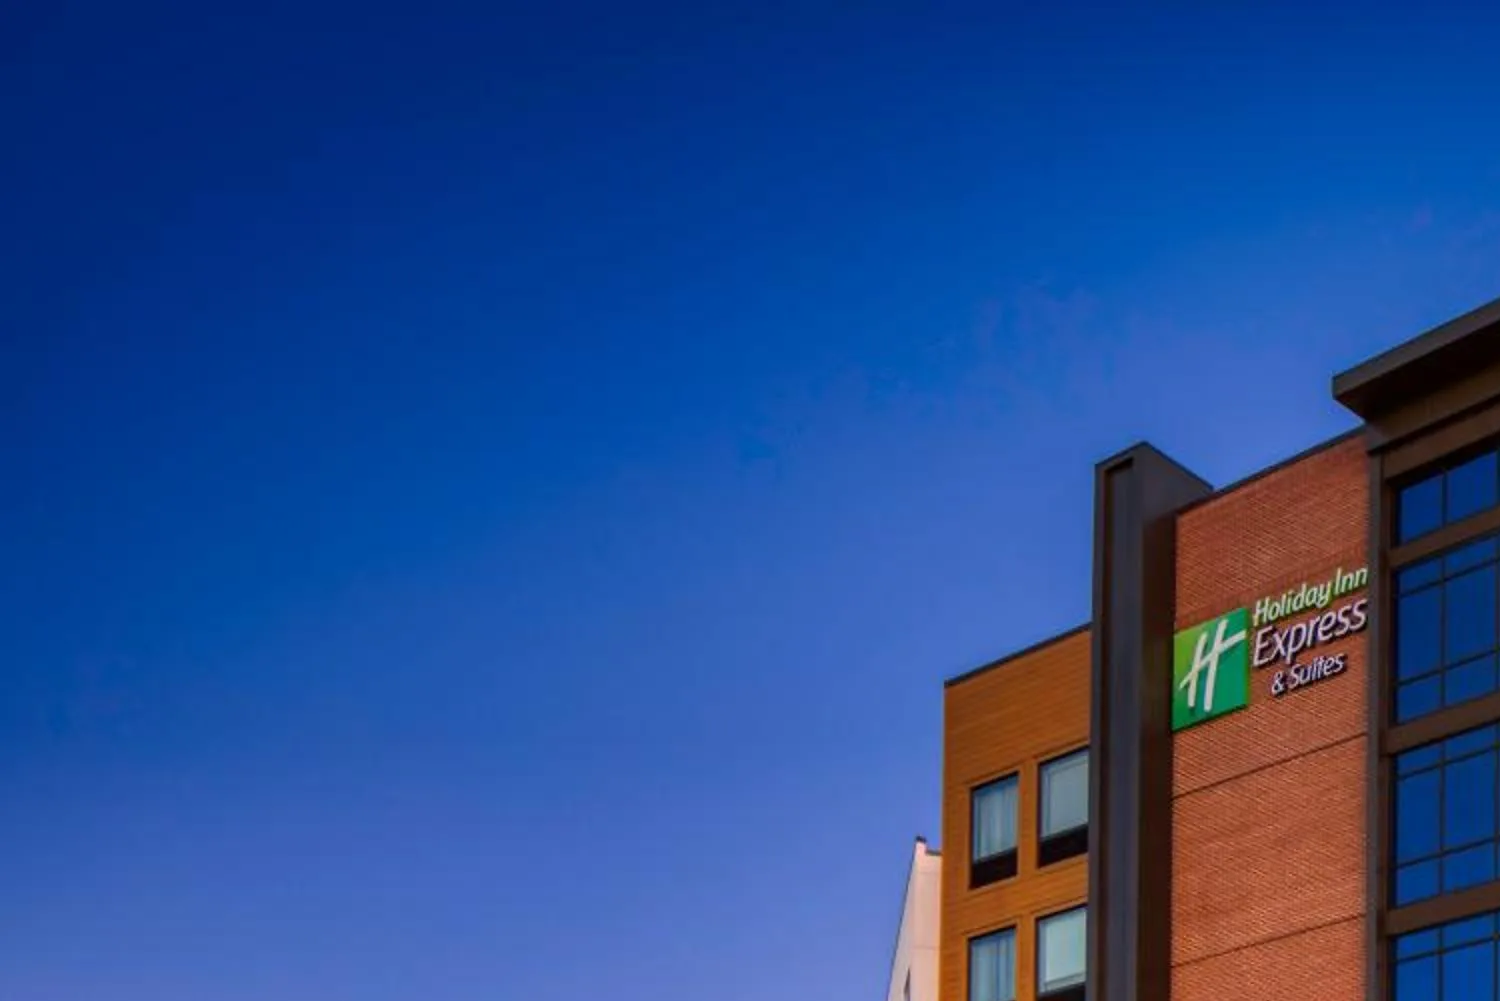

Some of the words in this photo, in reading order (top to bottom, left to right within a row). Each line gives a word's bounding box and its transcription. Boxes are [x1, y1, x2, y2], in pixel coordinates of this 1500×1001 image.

[1252, 582, 1332, 627] Holiday
[1335, 567, 1369, 596] Inn
[1252, 598, 1368, 668] Express
[1270, 671, 1286, 695] &
[1288, 653, 1346, 690] Suites
